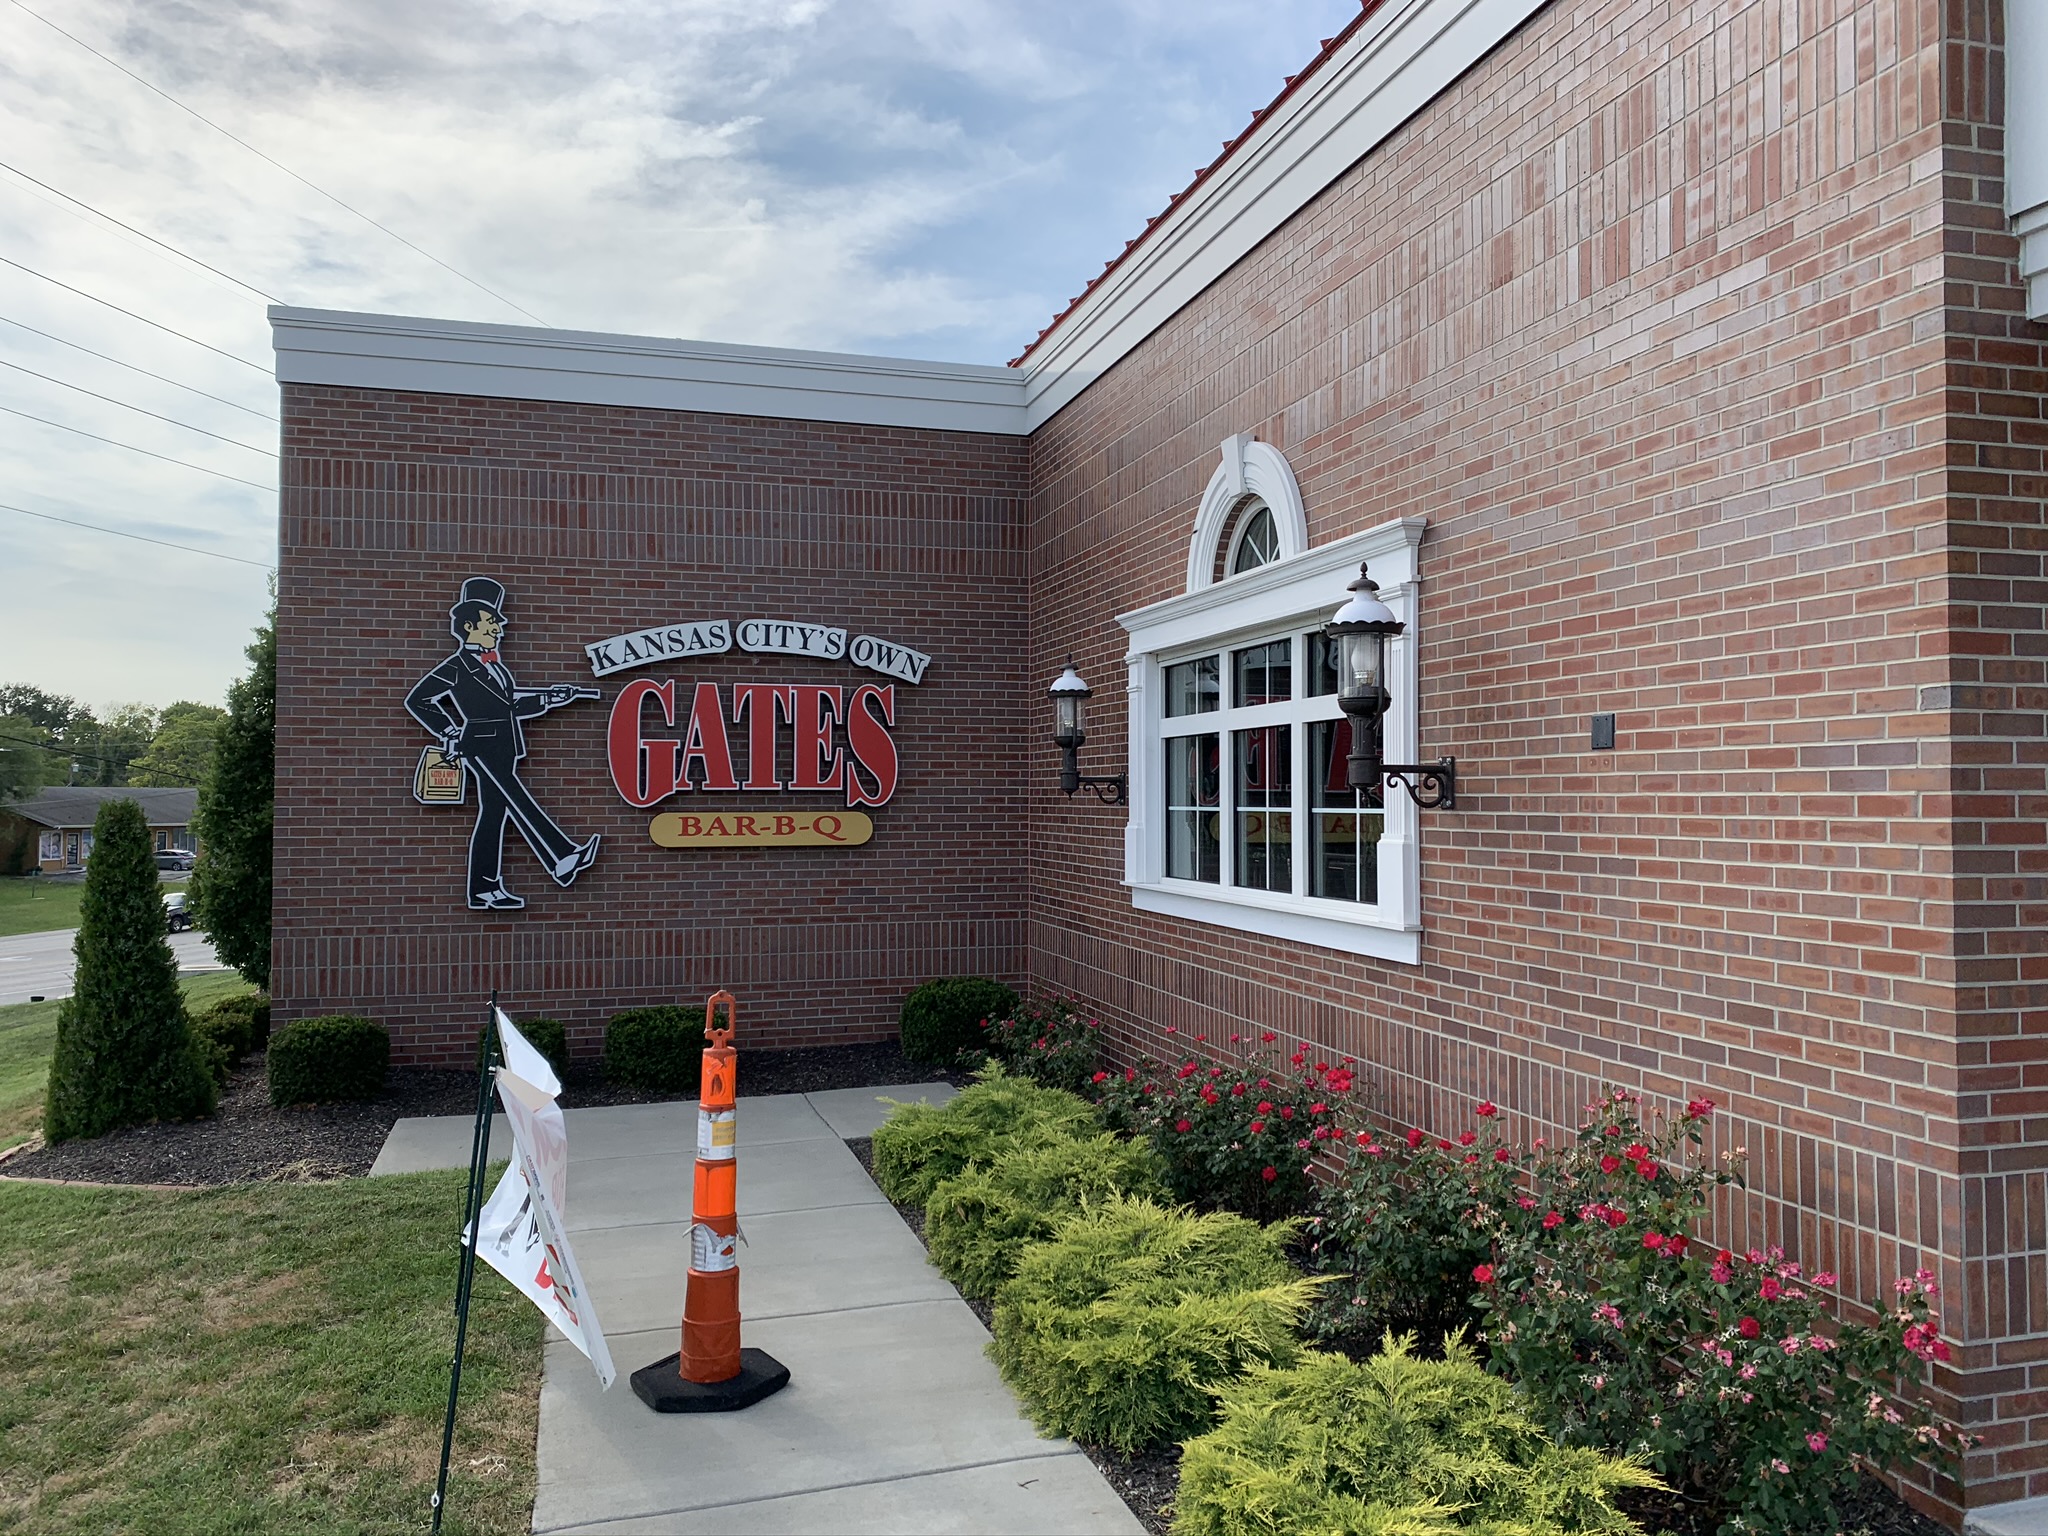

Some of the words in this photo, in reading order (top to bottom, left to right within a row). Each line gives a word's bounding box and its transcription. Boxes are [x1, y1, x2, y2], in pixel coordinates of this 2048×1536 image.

[591, 624, 726, 671] KANSAS
[741, 623, 842, 655] CITY'S
[855, 639, 925, 679] OWN
[607, 678, 898, 809] GATES
[678, 815, 847, 841] BAR-B-Q
